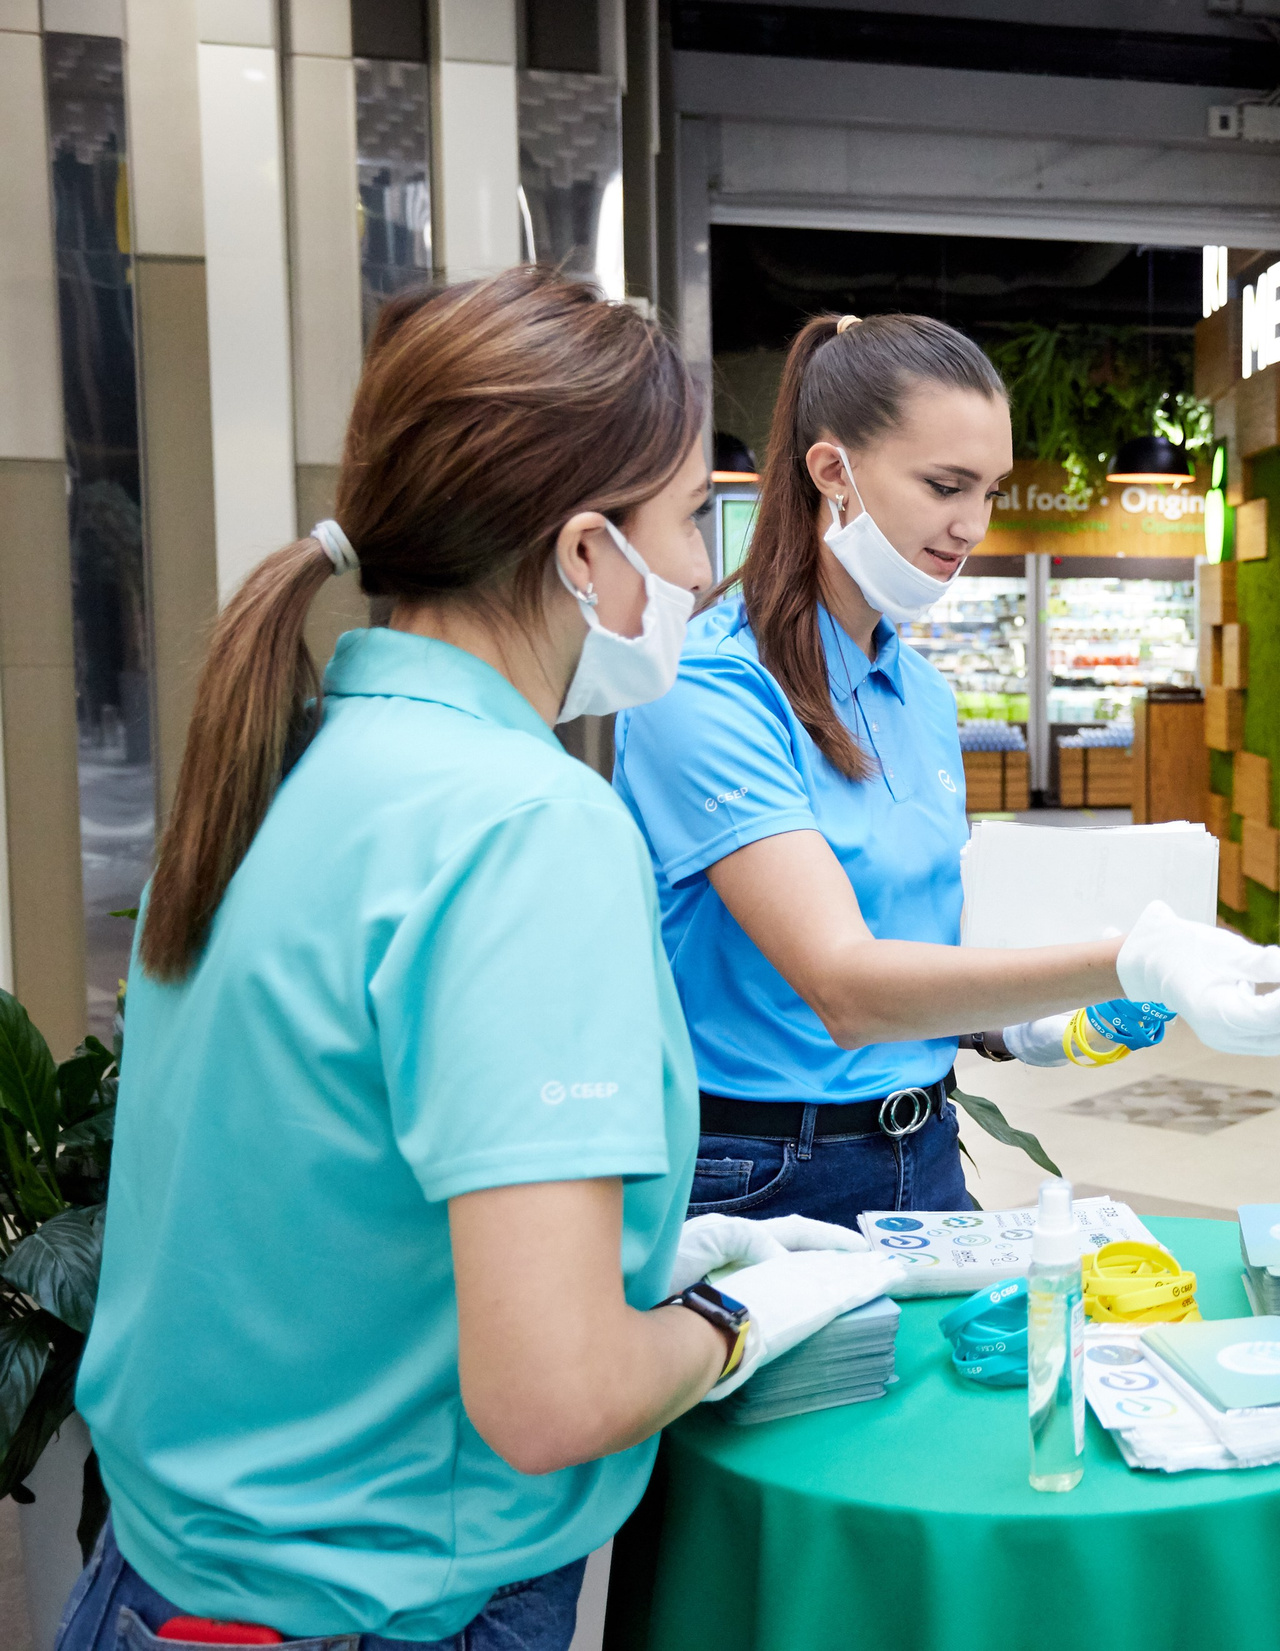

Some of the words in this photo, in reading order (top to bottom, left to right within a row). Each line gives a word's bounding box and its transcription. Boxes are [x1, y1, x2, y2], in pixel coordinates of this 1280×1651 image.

[995, 484, 1021, 511] al
[1121, 486, 1205, 520] Origin
[717, 786, 748, 804] СБЕР
[1150, 1010, 1168, 1020] СБЕР
[570, 1082, 619, 1099] СБЕР
